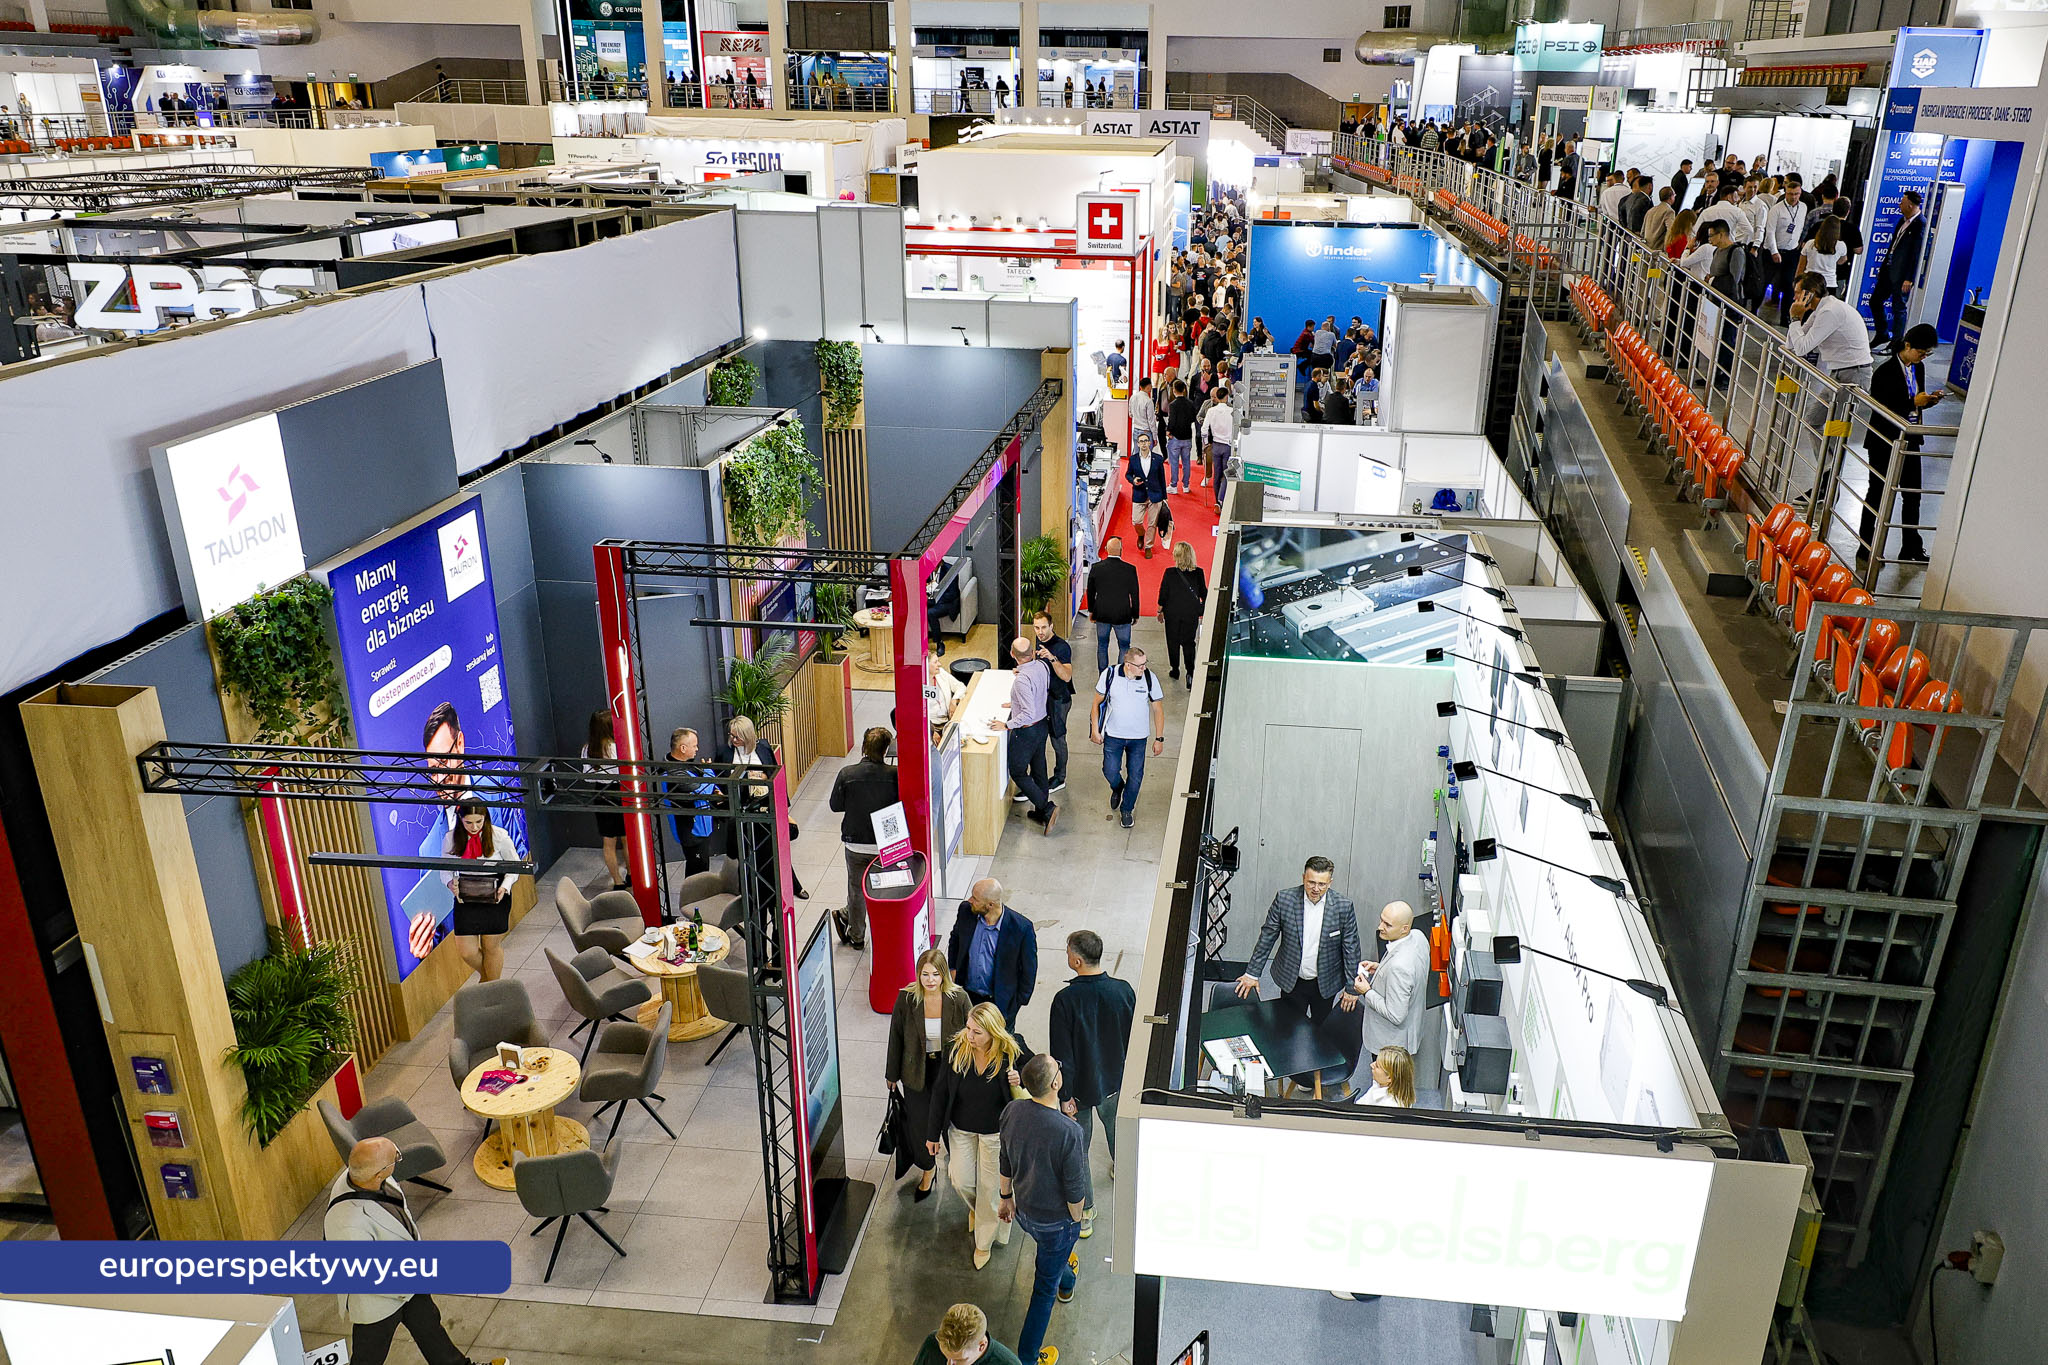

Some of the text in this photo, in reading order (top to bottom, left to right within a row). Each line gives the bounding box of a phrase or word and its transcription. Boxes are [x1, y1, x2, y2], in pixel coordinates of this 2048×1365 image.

[719, 37, 763, 52] REPL
[1516, 40, 1531, 55] PSI
[1544, 41, 1580, 52] PSI
[1921, 104, 1940, 117] ENERGIA
[1968, 106, 1992, 121] PROCESIE
[1993, 107, 2011, 122] DANE
[1092, 123, 1133, 134] ASTAT
[1148, 119, 1201, 135] ASTAT
[1909, 147, 1941, 157] SMART
[1907, 158, 1954, 167] METERNG
[1885, 167, 1917, 176] TRANSMISJA
[1323, 244, 1373, 256] finder
[203, 512, 288, 567] TAURON
[448, 553, 478, 580] TAURON
[354, 559, 397, 596] Mamy
[360, 583, 410, 624] energię
[365, 599, 436, 654] dla biznesu
[485, 632, 494, 645] lub
[486, 644, 496, 658] kod
[370, 657, 398, 683] Sprawdź
[375, 659, 438, 709] dostepnemoce.pl
[924, 690, 937, 699] 50
[1546, 866, 1595, 1024] Abox Abox Pro
[1150, 1150, 1254, 1244] els
[1305, 1174, 1688, 1296] spelsberg
[312, 1352, 339, 1365] 49
